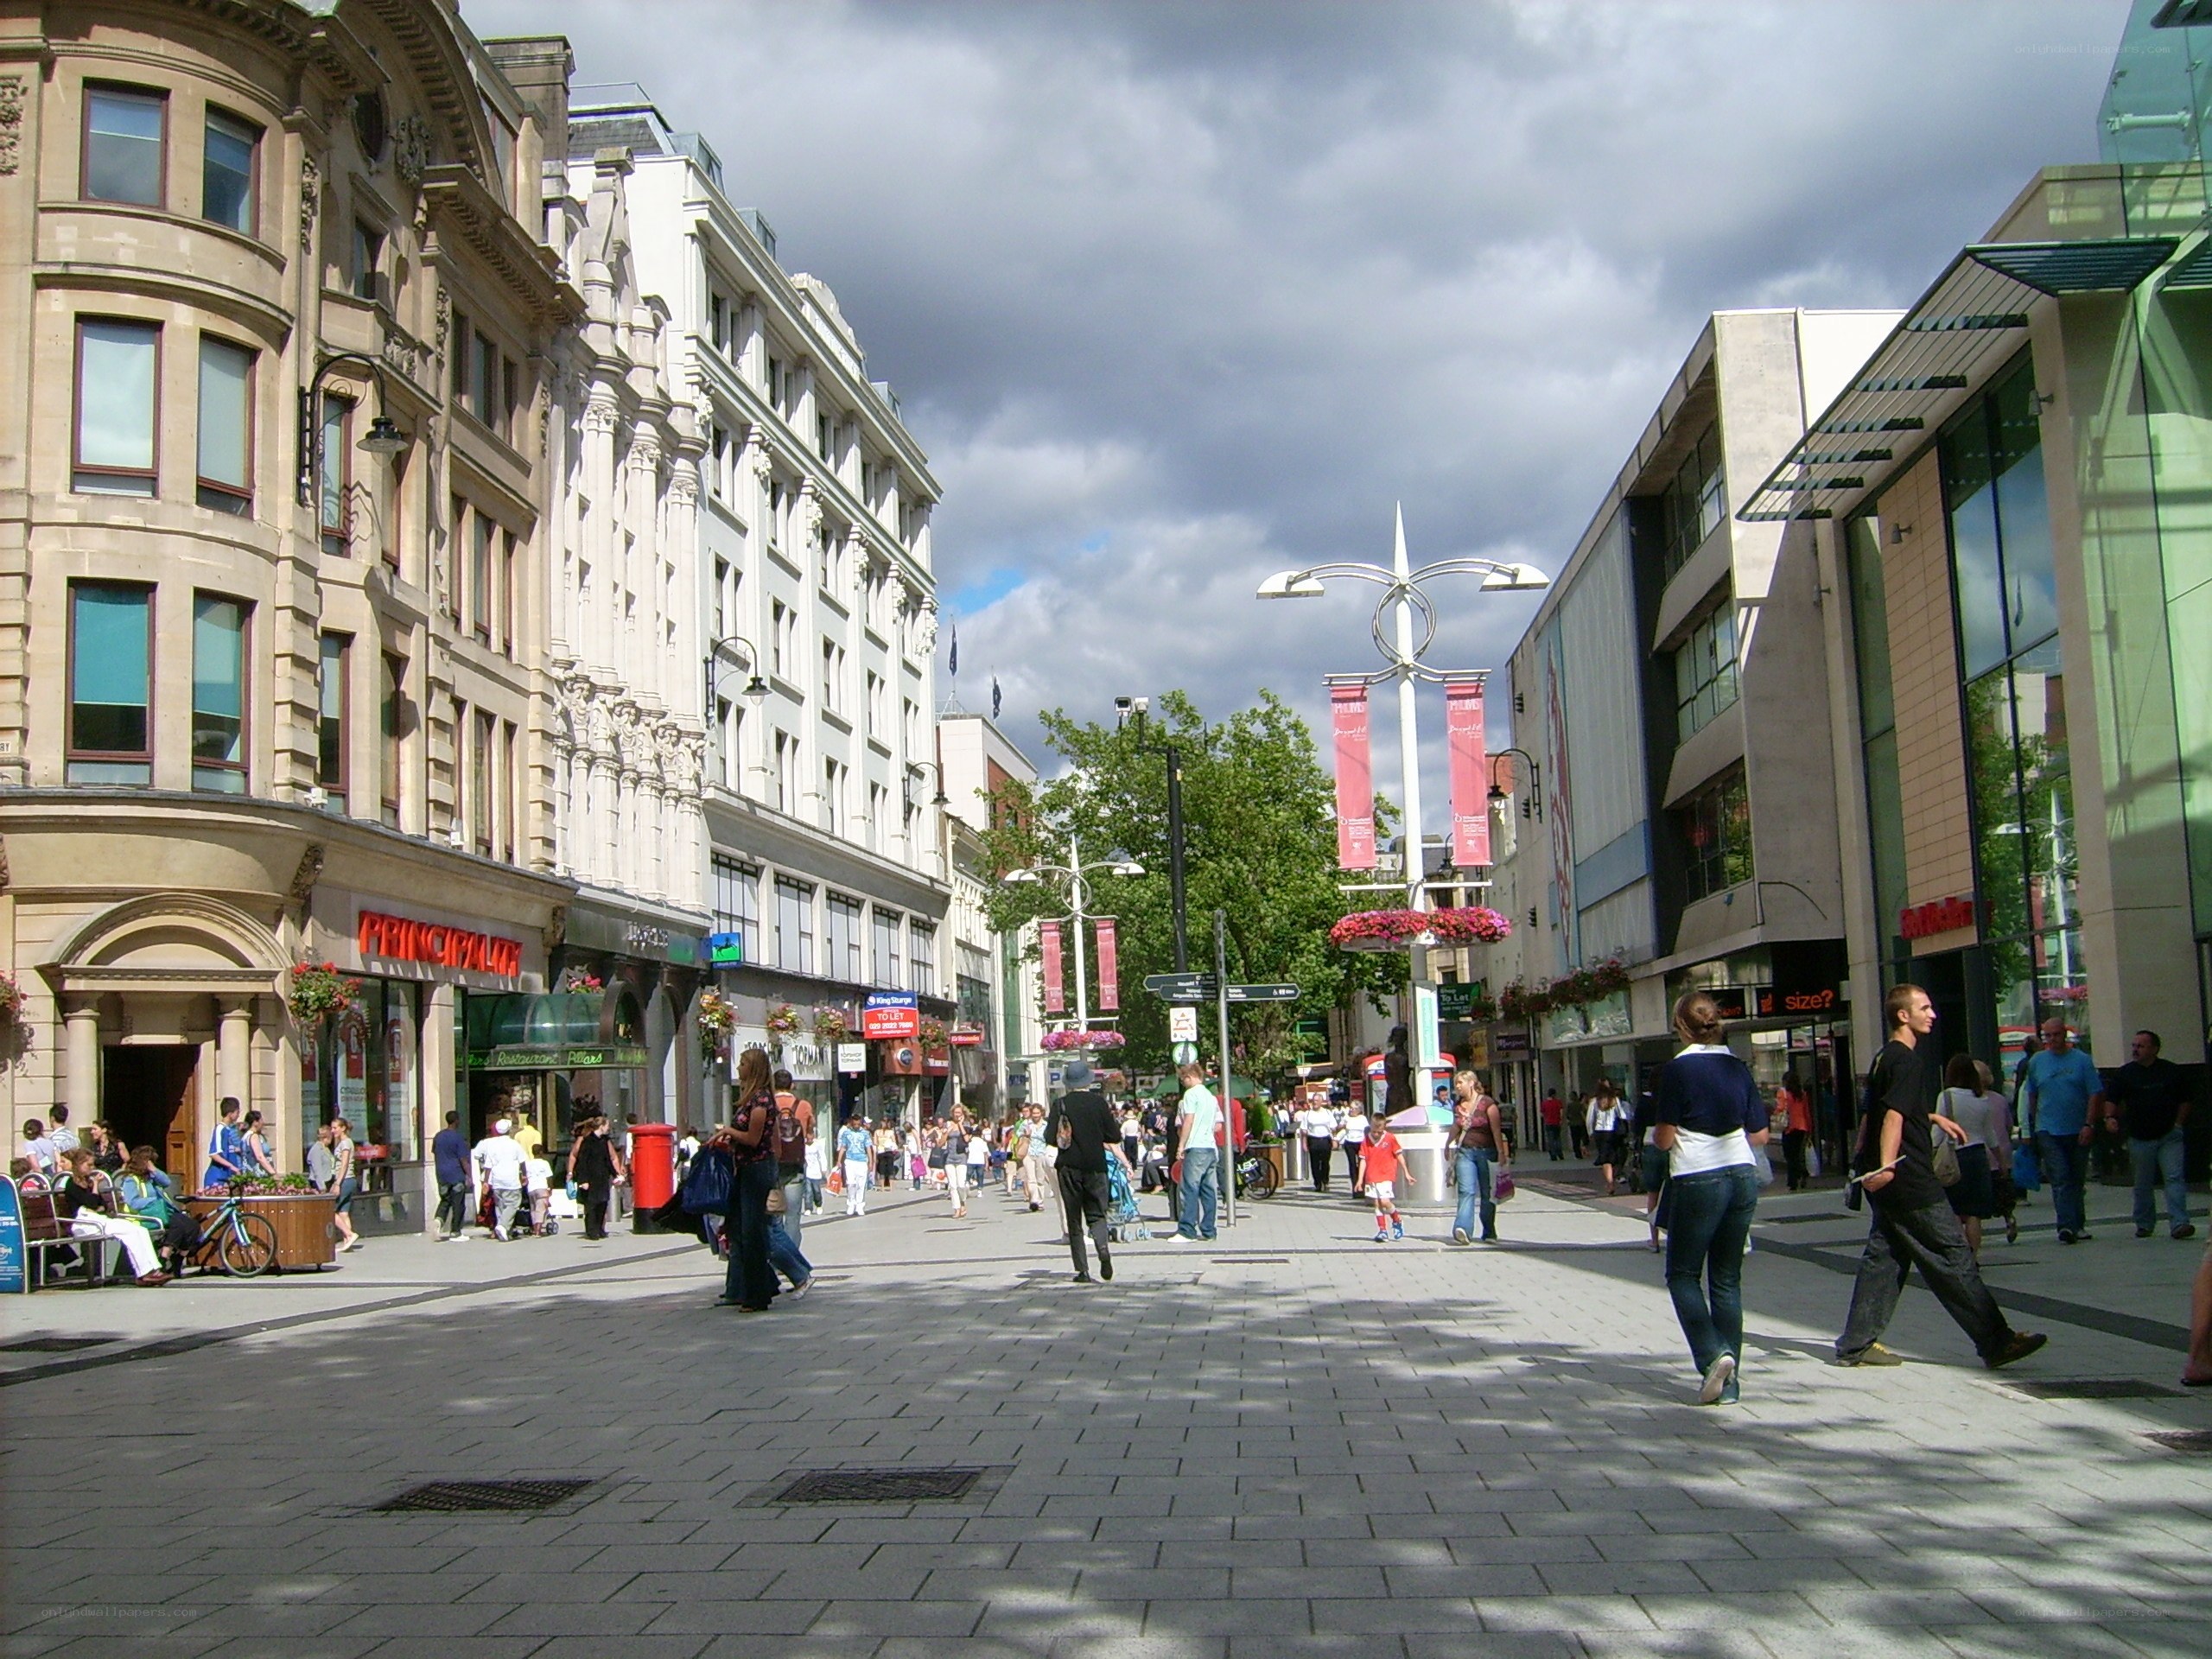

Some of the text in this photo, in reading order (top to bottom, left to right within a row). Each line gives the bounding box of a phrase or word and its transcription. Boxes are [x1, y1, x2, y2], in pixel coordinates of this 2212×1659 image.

[359, 910, 523, 977] PRINCIPALITY
[876, 996, 891, 1005] King
[1785, 989, 1834, 1010] size?
[890, 1012, 905, 1020] LET
[496, 1051, 558, 1065] Restaurant
